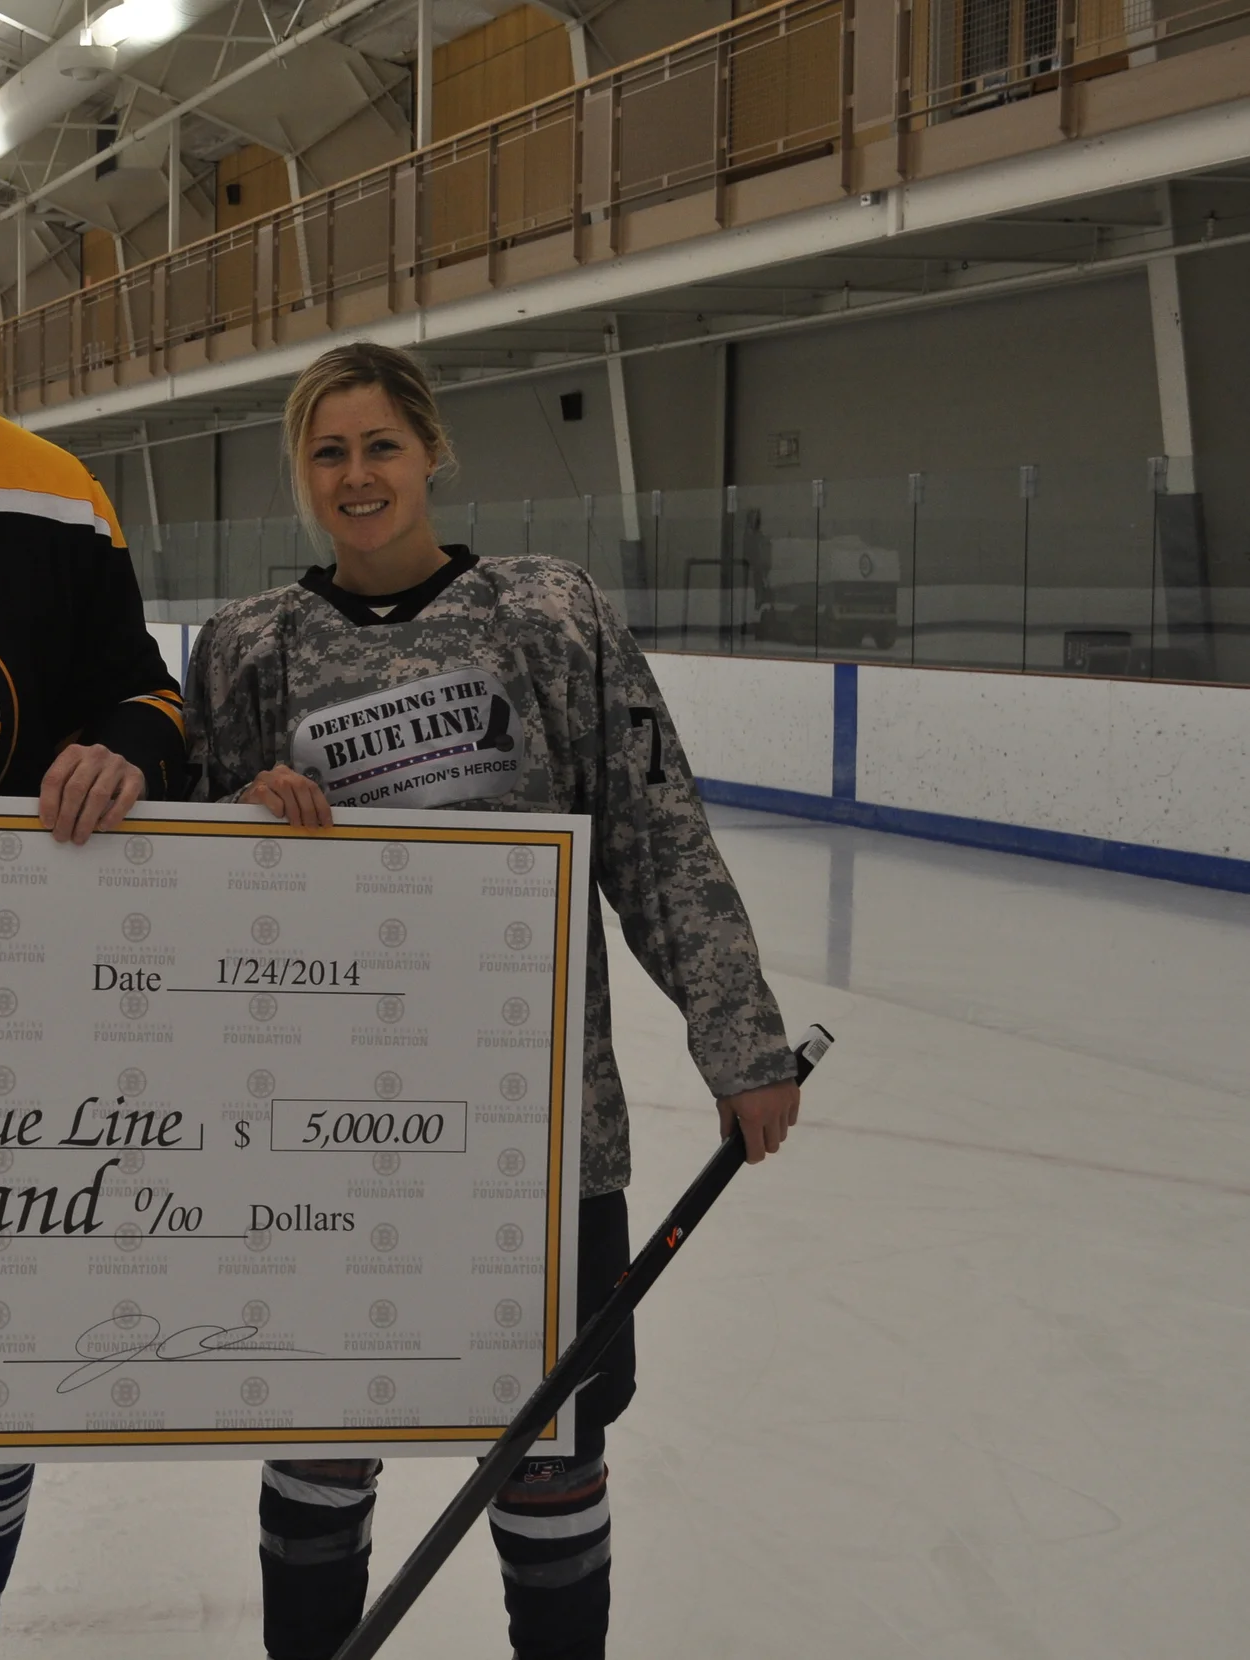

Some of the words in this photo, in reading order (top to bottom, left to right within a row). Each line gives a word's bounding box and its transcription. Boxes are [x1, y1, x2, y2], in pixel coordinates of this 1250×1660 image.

[308, 690, 436, 740] DEFENDING
[440, 680, 488, 702] THE
[323, 723, 404, 770] BLUE
[410, 706, 483, 744] LINE
[360, 784, 390, 802] OUR
[394, 767, 460, 794] NATION'S
[464, 759, 517, 776] HEROES
[97, 875, 177, 889] FOUNDATION
[227, 879, 305, 892] FOUNDATION
[355, 882, 432, 895] FOUNDATION
[92, 964, 162, 991] Date
[216, 958, 360, 986] 1/24/2014
[93, 1030, 173, 1044] FOUNDATION
[223, 1032, 300, 1045] FOUNDATION
[350, 1034, 427, 1047] FOUNDATION
[58, 1095, 182, 1146] Line
[234, 1119, 250, 1150] $
[302, 1110, 444, 1149] 5,000.00
[346, 1186, 423, 1199] FOUNDATION
[249, 1204, 355, 1231] Dollars
[88, 1263, 166, 1276] FOUNDATION
[217, 1263, 295, 1276] FOUNDATION
[345, 1263, 422, 1276] FOUNDATION
[343, 1339, 420, 1352] FOUNDATION
